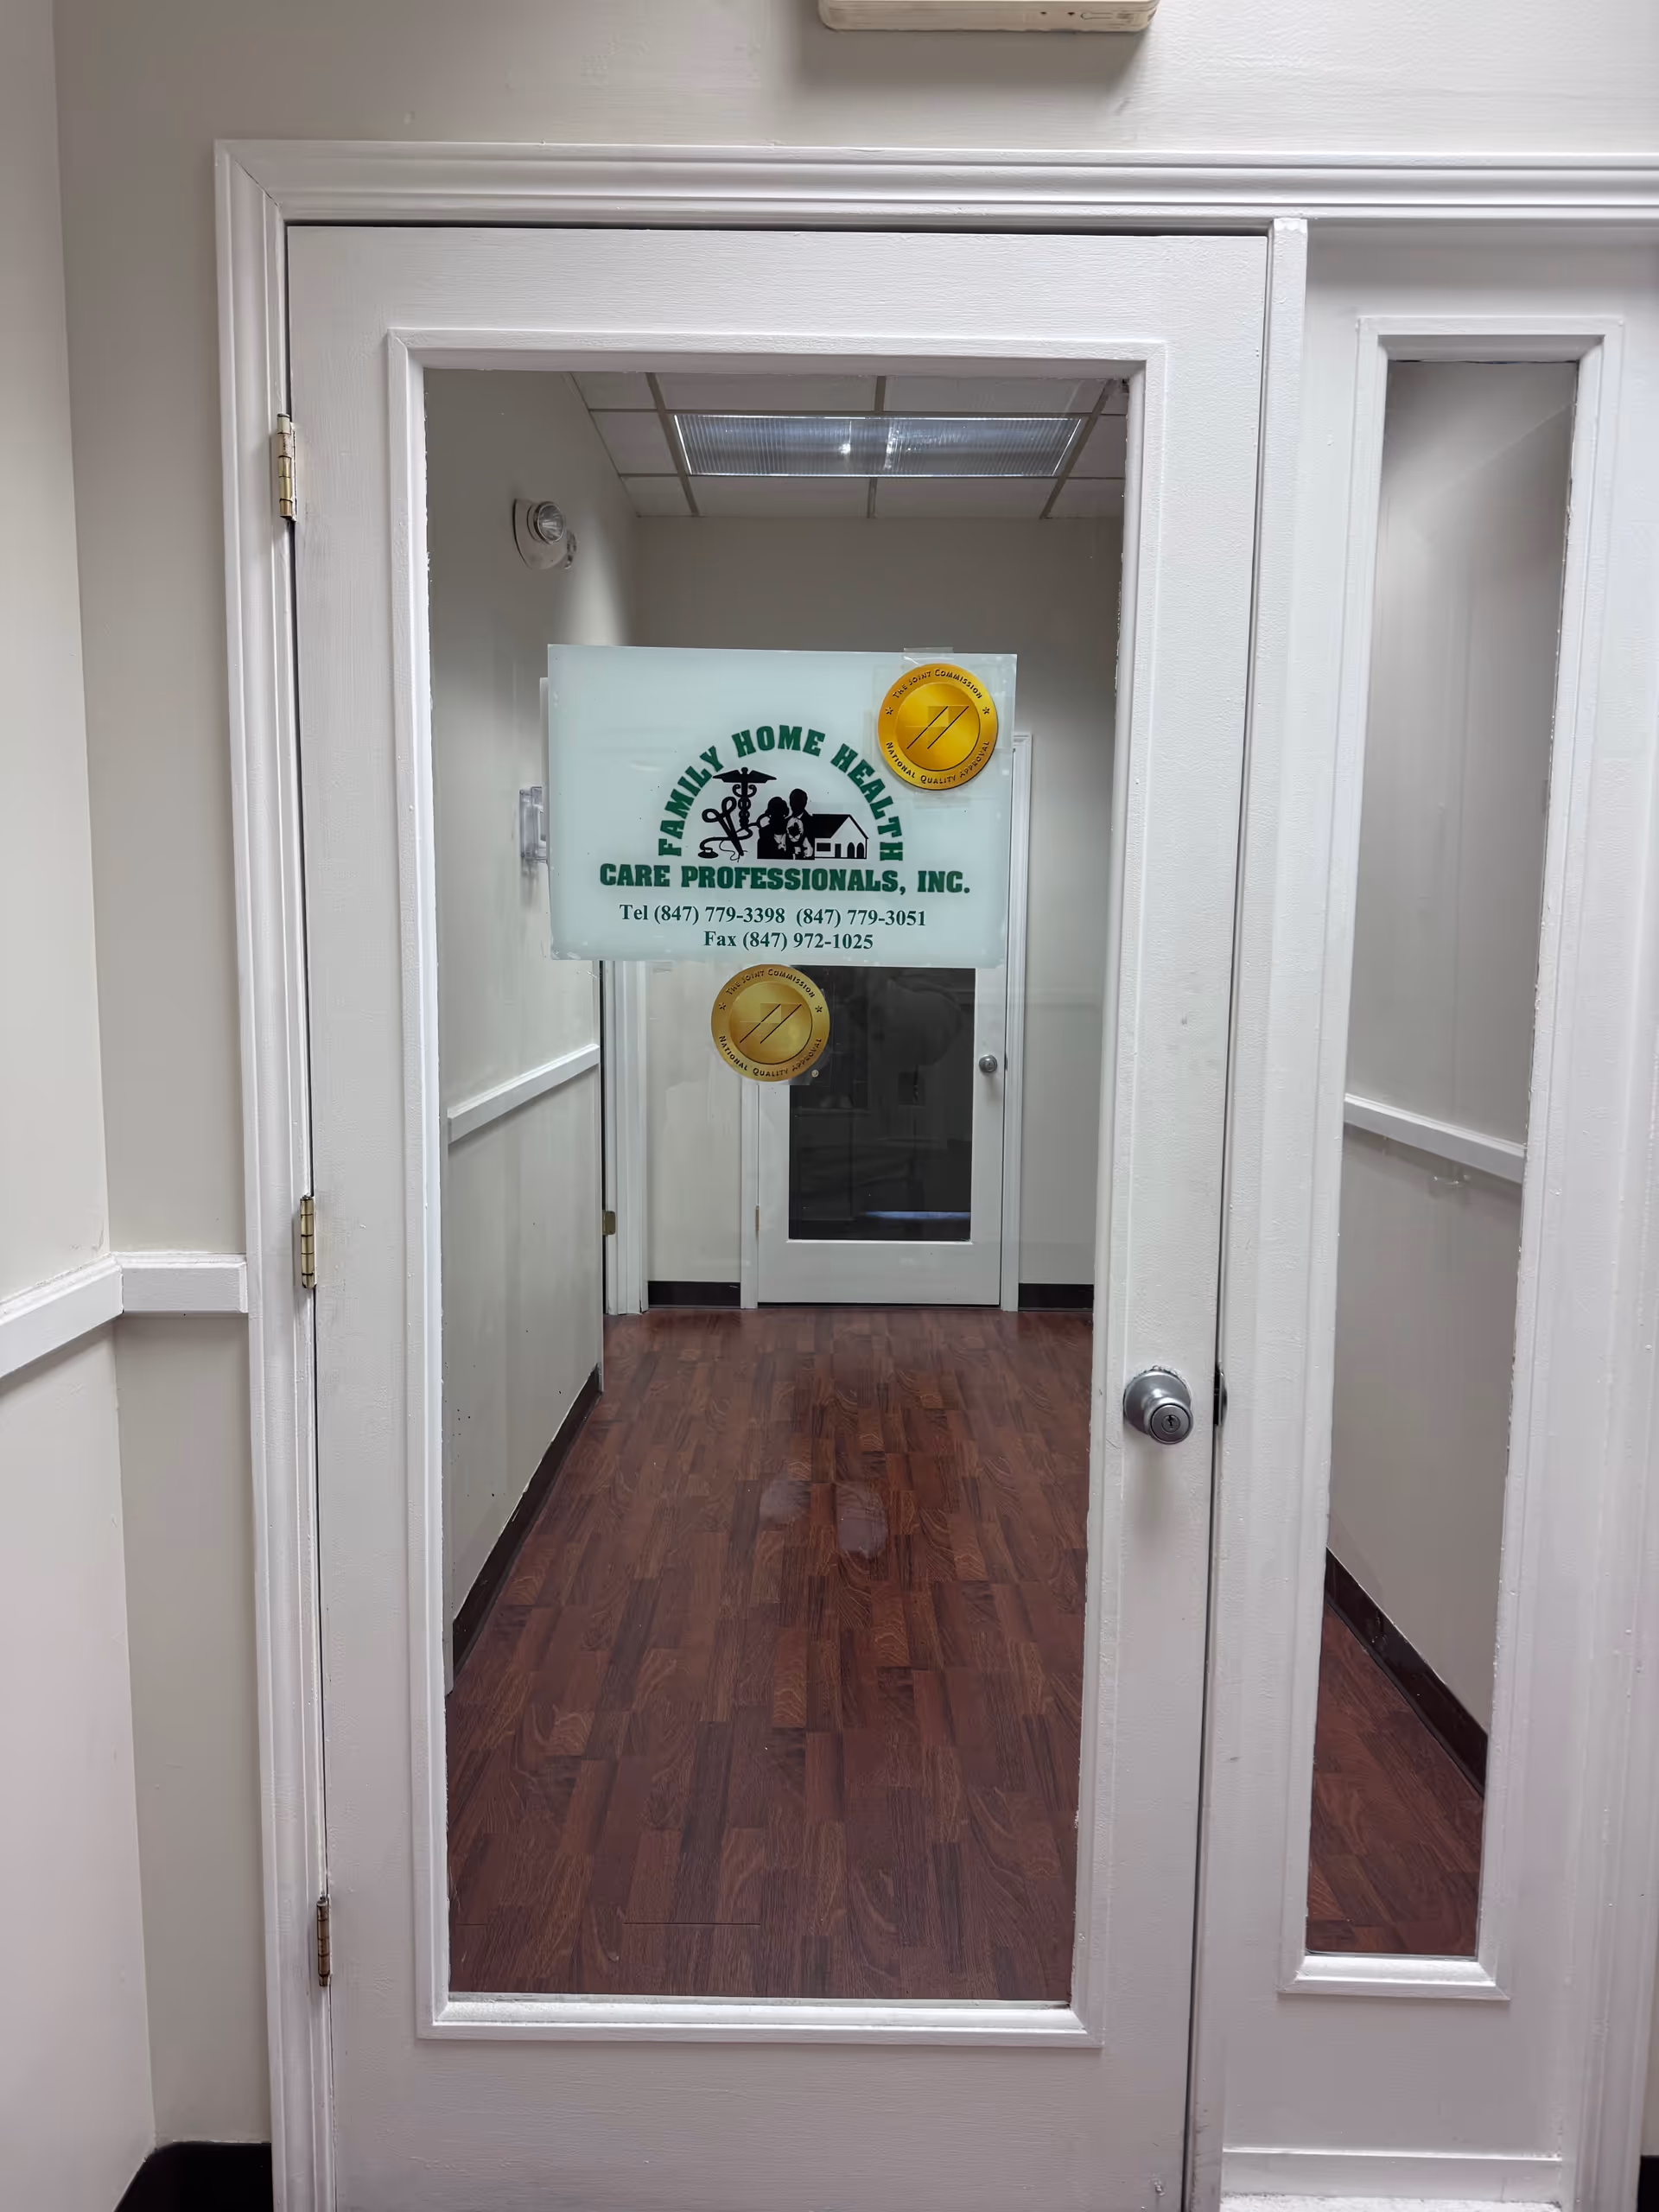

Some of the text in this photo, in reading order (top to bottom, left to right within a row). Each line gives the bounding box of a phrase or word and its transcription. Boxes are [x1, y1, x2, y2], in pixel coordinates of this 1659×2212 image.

[658, 725, 903, 861] FAMILY HOME HEALTH
[600, 863, 970, 895] CARE PROFESSIONALS, INC.
[620, 905, 925, 928] Tel (847) 779-3398 (847) 779-3051
[703, 931, 874, 951] Fax (847) 972-1025
